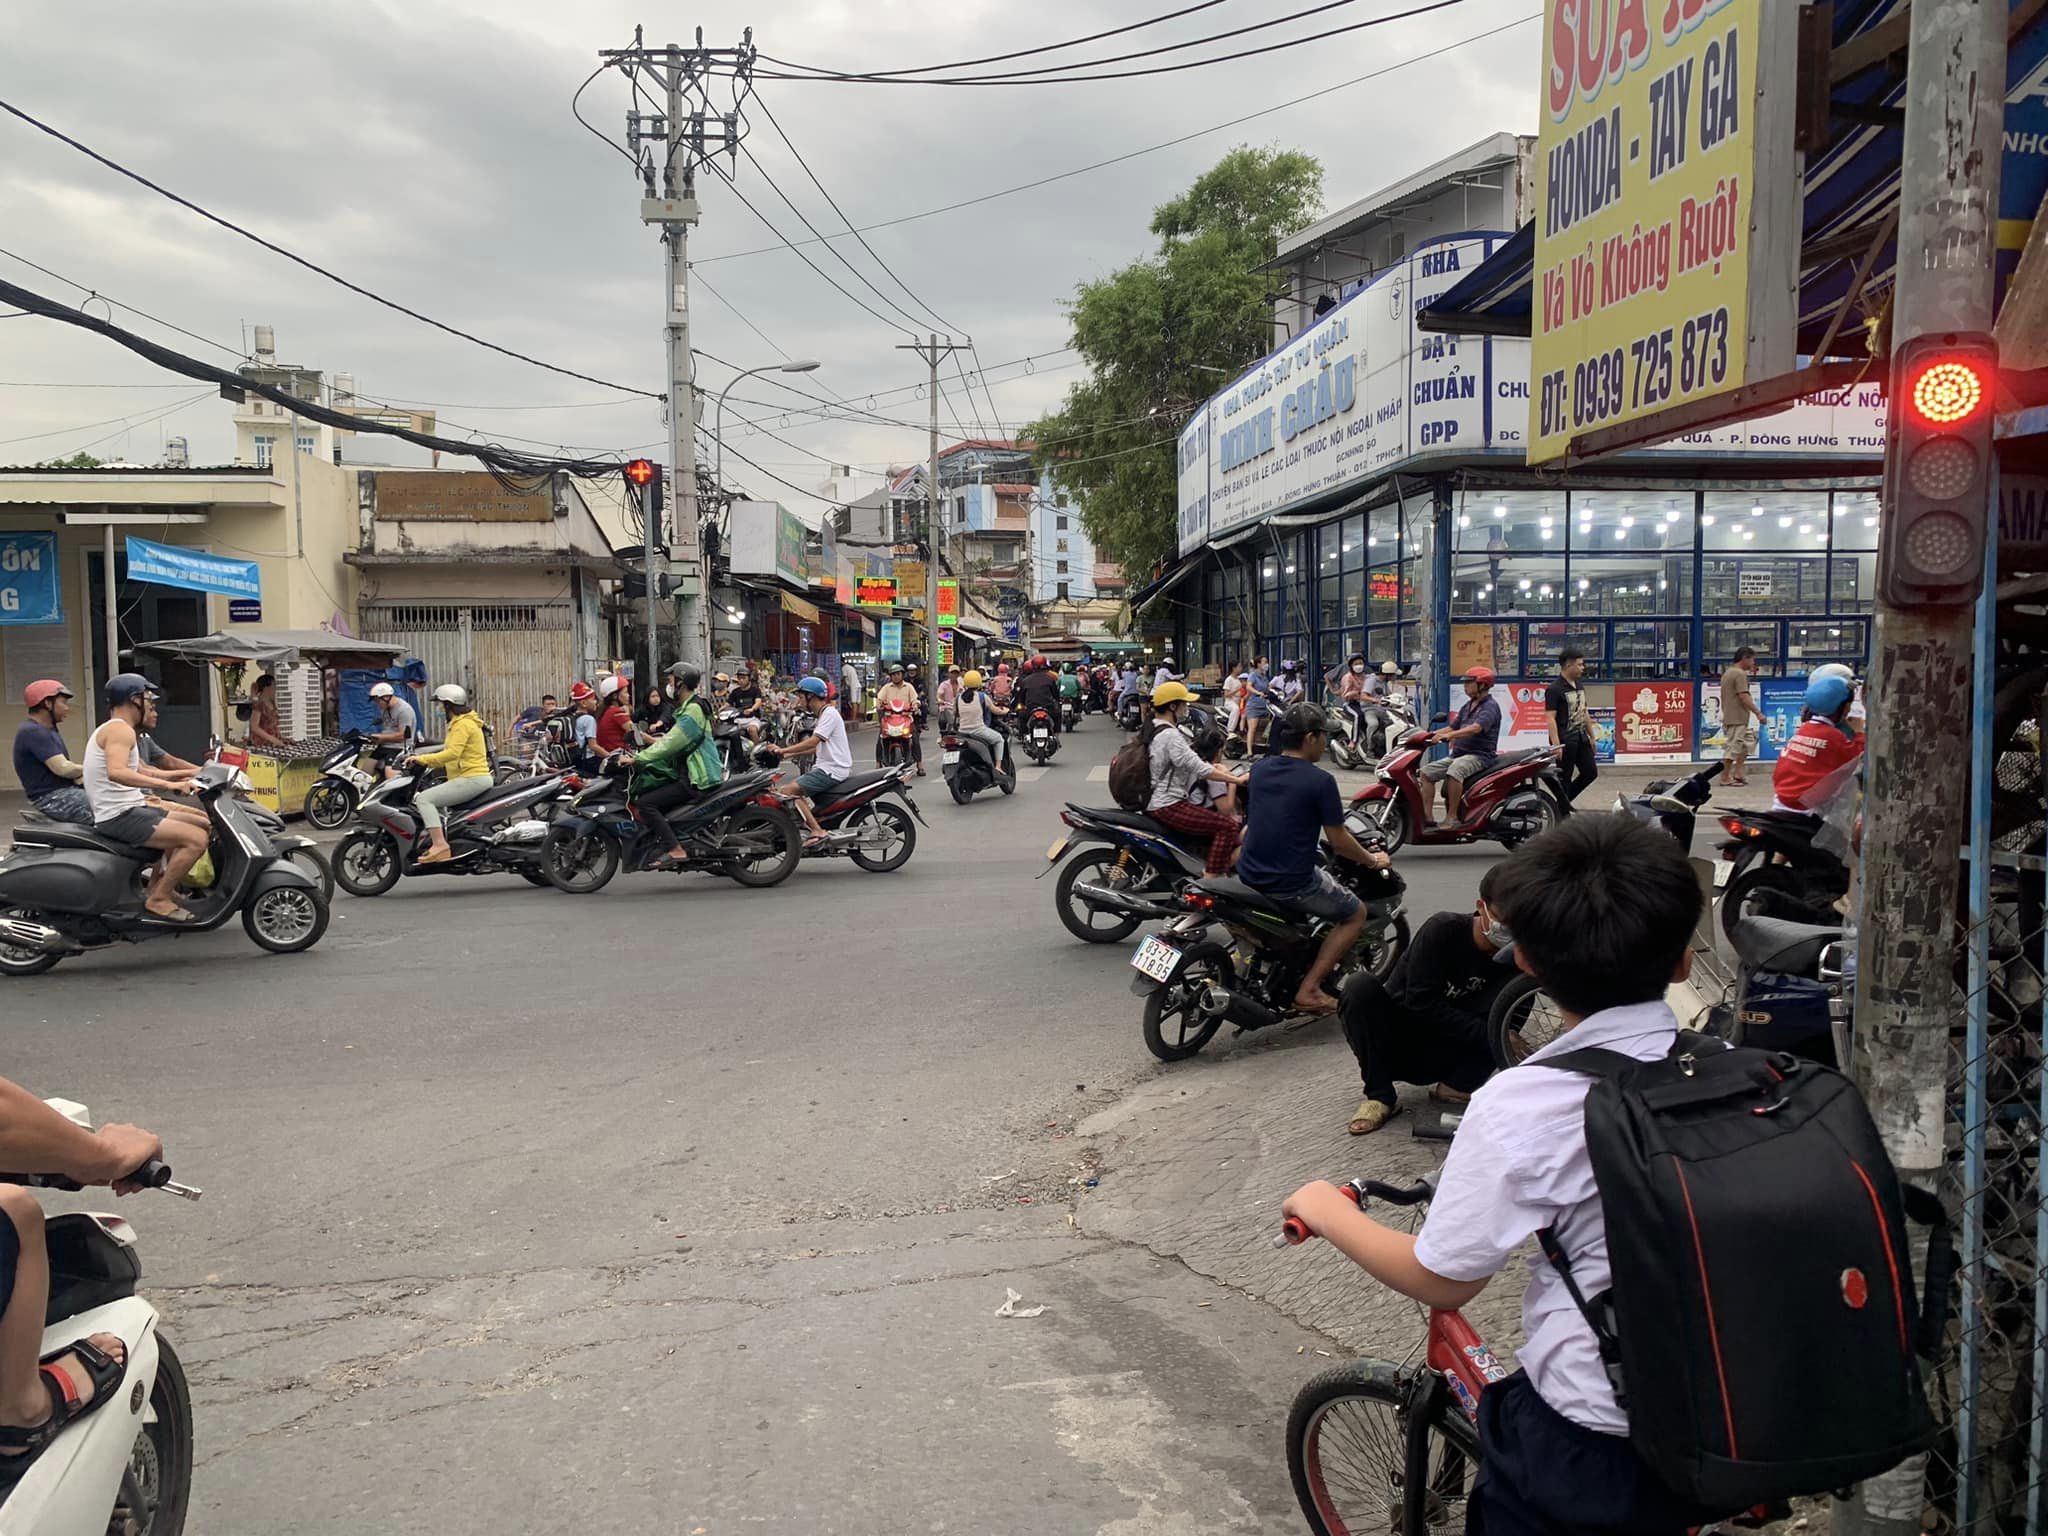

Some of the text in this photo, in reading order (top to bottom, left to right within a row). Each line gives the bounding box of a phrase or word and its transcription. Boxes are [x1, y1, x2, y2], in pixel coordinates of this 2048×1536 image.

[1546, 106, 1621, 238] HONDA
[1650, 57, 1693, 180] TAY
[1701, 28, 1738, 150] GA
[1543, 177, 1738, 333] Vá Vỏ Không Ruột
[1281, 355, 1357, 443] CHÂU
[1414, 365, 1475, 405] CHUẨN
[1540, 307, 1728, 437] ĐT: 0939 725 873
[1421, 420, 1459, 446] GPP
[1798, 433, 1839, 446] HƯNG
[1145, 941, 1175, 965] 83-Z1
